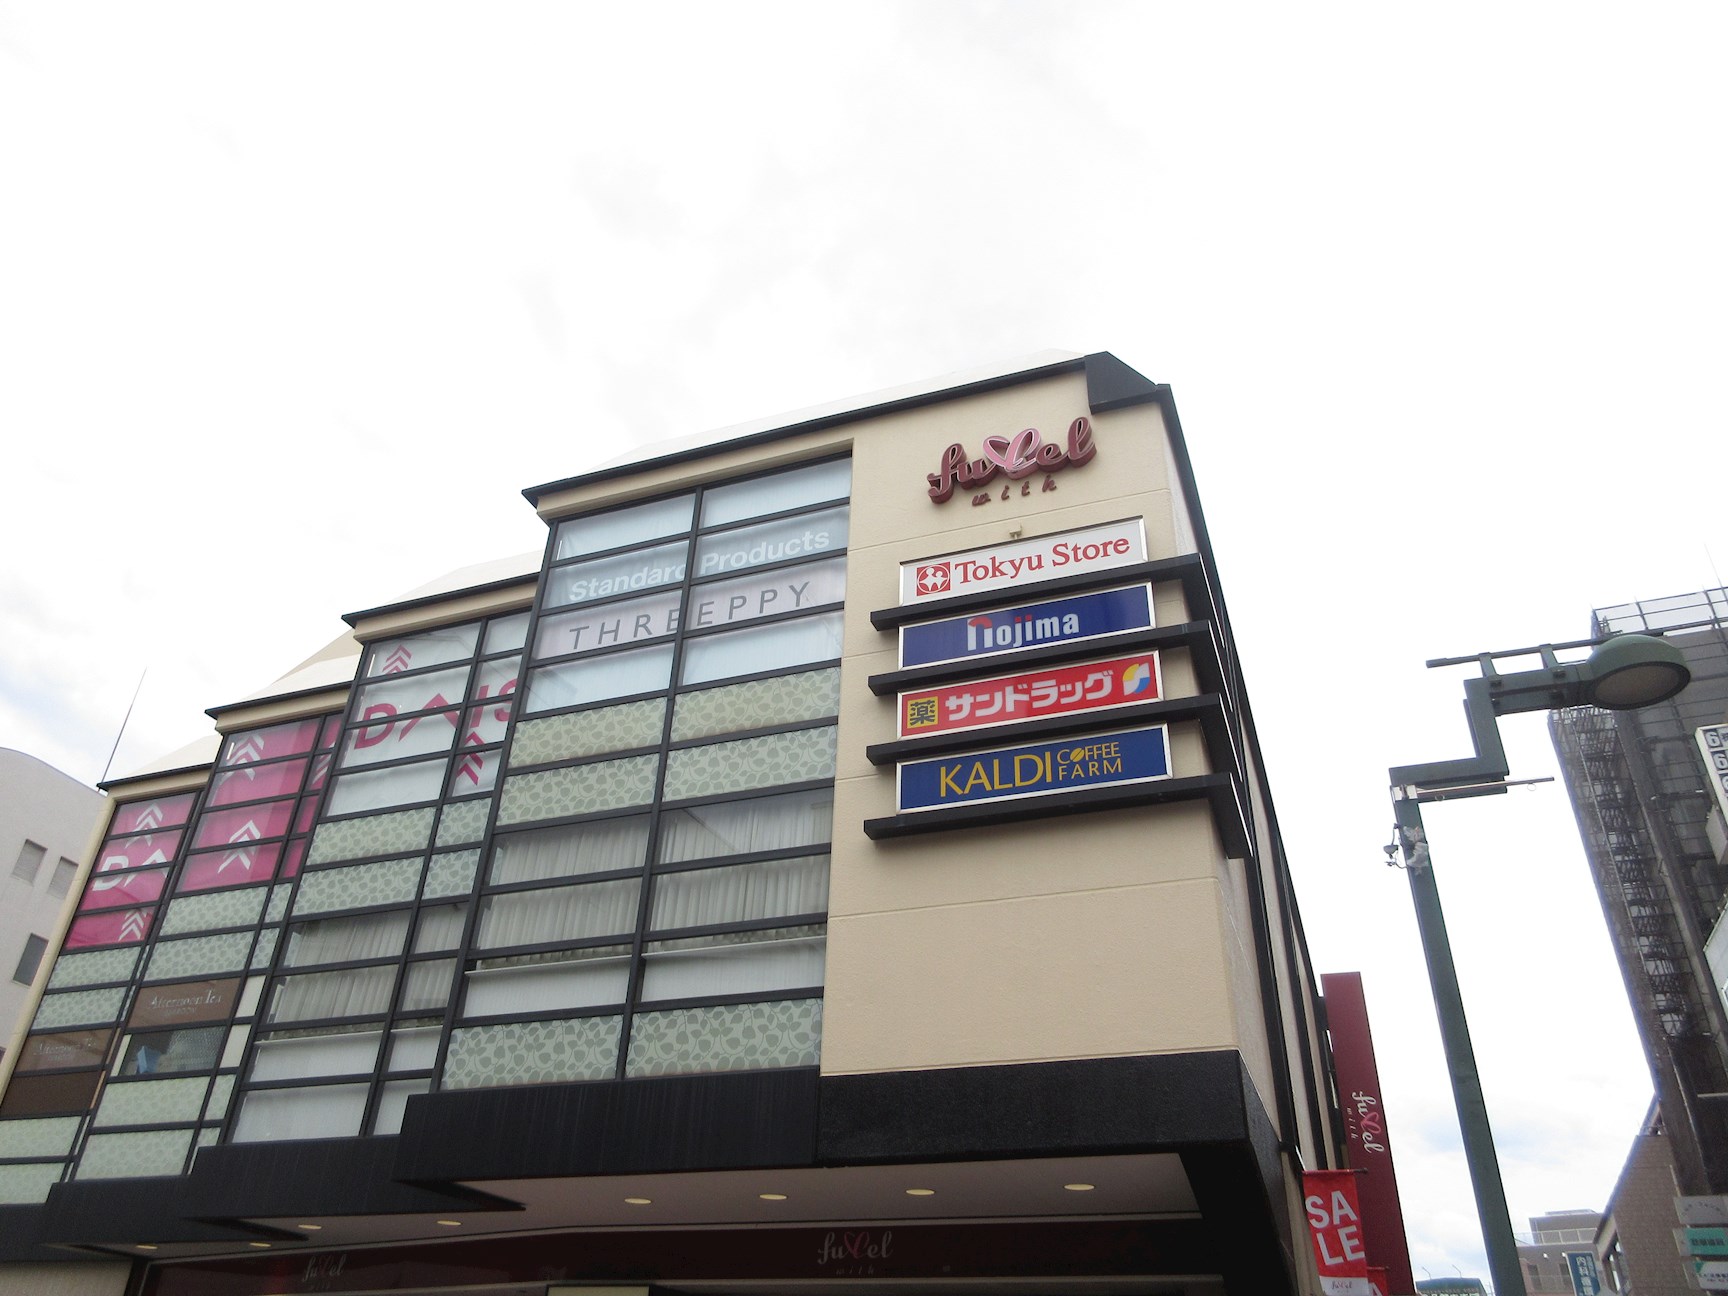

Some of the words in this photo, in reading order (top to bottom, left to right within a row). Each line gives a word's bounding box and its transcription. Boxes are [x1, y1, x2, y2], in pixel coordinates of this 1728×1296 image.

[972, 475, 1057, 506] with
[701, 530, 830, 574] Products
[954, 555, 1044, 584] Tokyu
[1051, 537, 1130, 567] Store
[569, 582, 810, 650] THREEPPY
[967, 613, 1080, 651] nojima
[909, 702, 936, 727] 薬
[945, 670, 1114, 720] サンドラッグ
[940, 752, 1052, 797] KALDI
[1057, 742, 1121, 765] COFFEE
[1059, 757, 1122, 780] FARM
